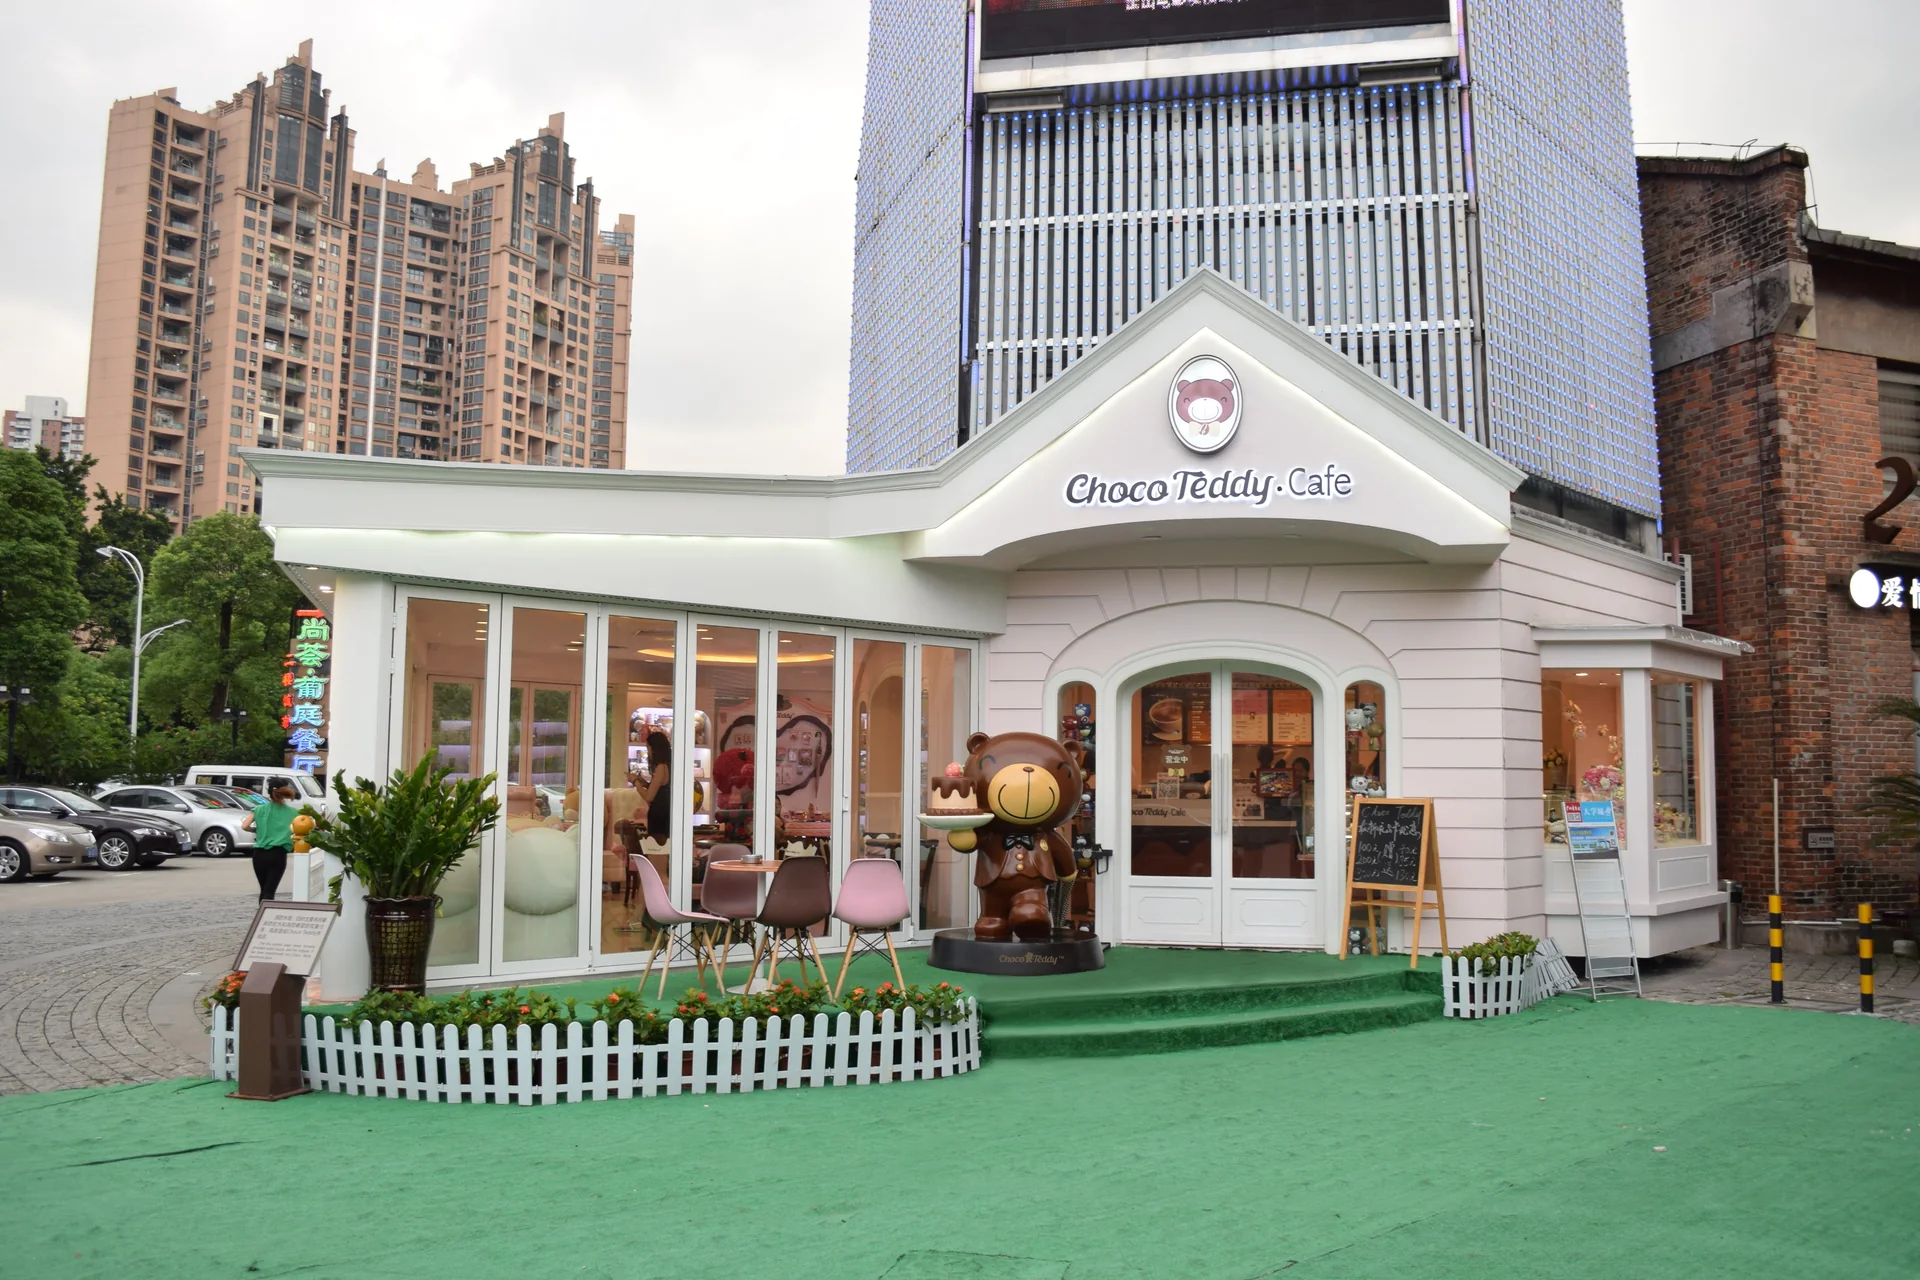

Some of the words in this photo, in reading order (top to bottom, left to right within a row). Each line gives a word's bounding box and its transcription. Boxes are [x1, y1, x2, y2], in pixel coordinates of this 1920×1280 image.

[1065, 473, 1169, 505] Choco
[1287, 463, 1352, 497] Cafe
[1864, 456, 1918, 544] 2
[1165, 755, 1189, 764] 营业中
[999, 954, 1025, 964] Choco
